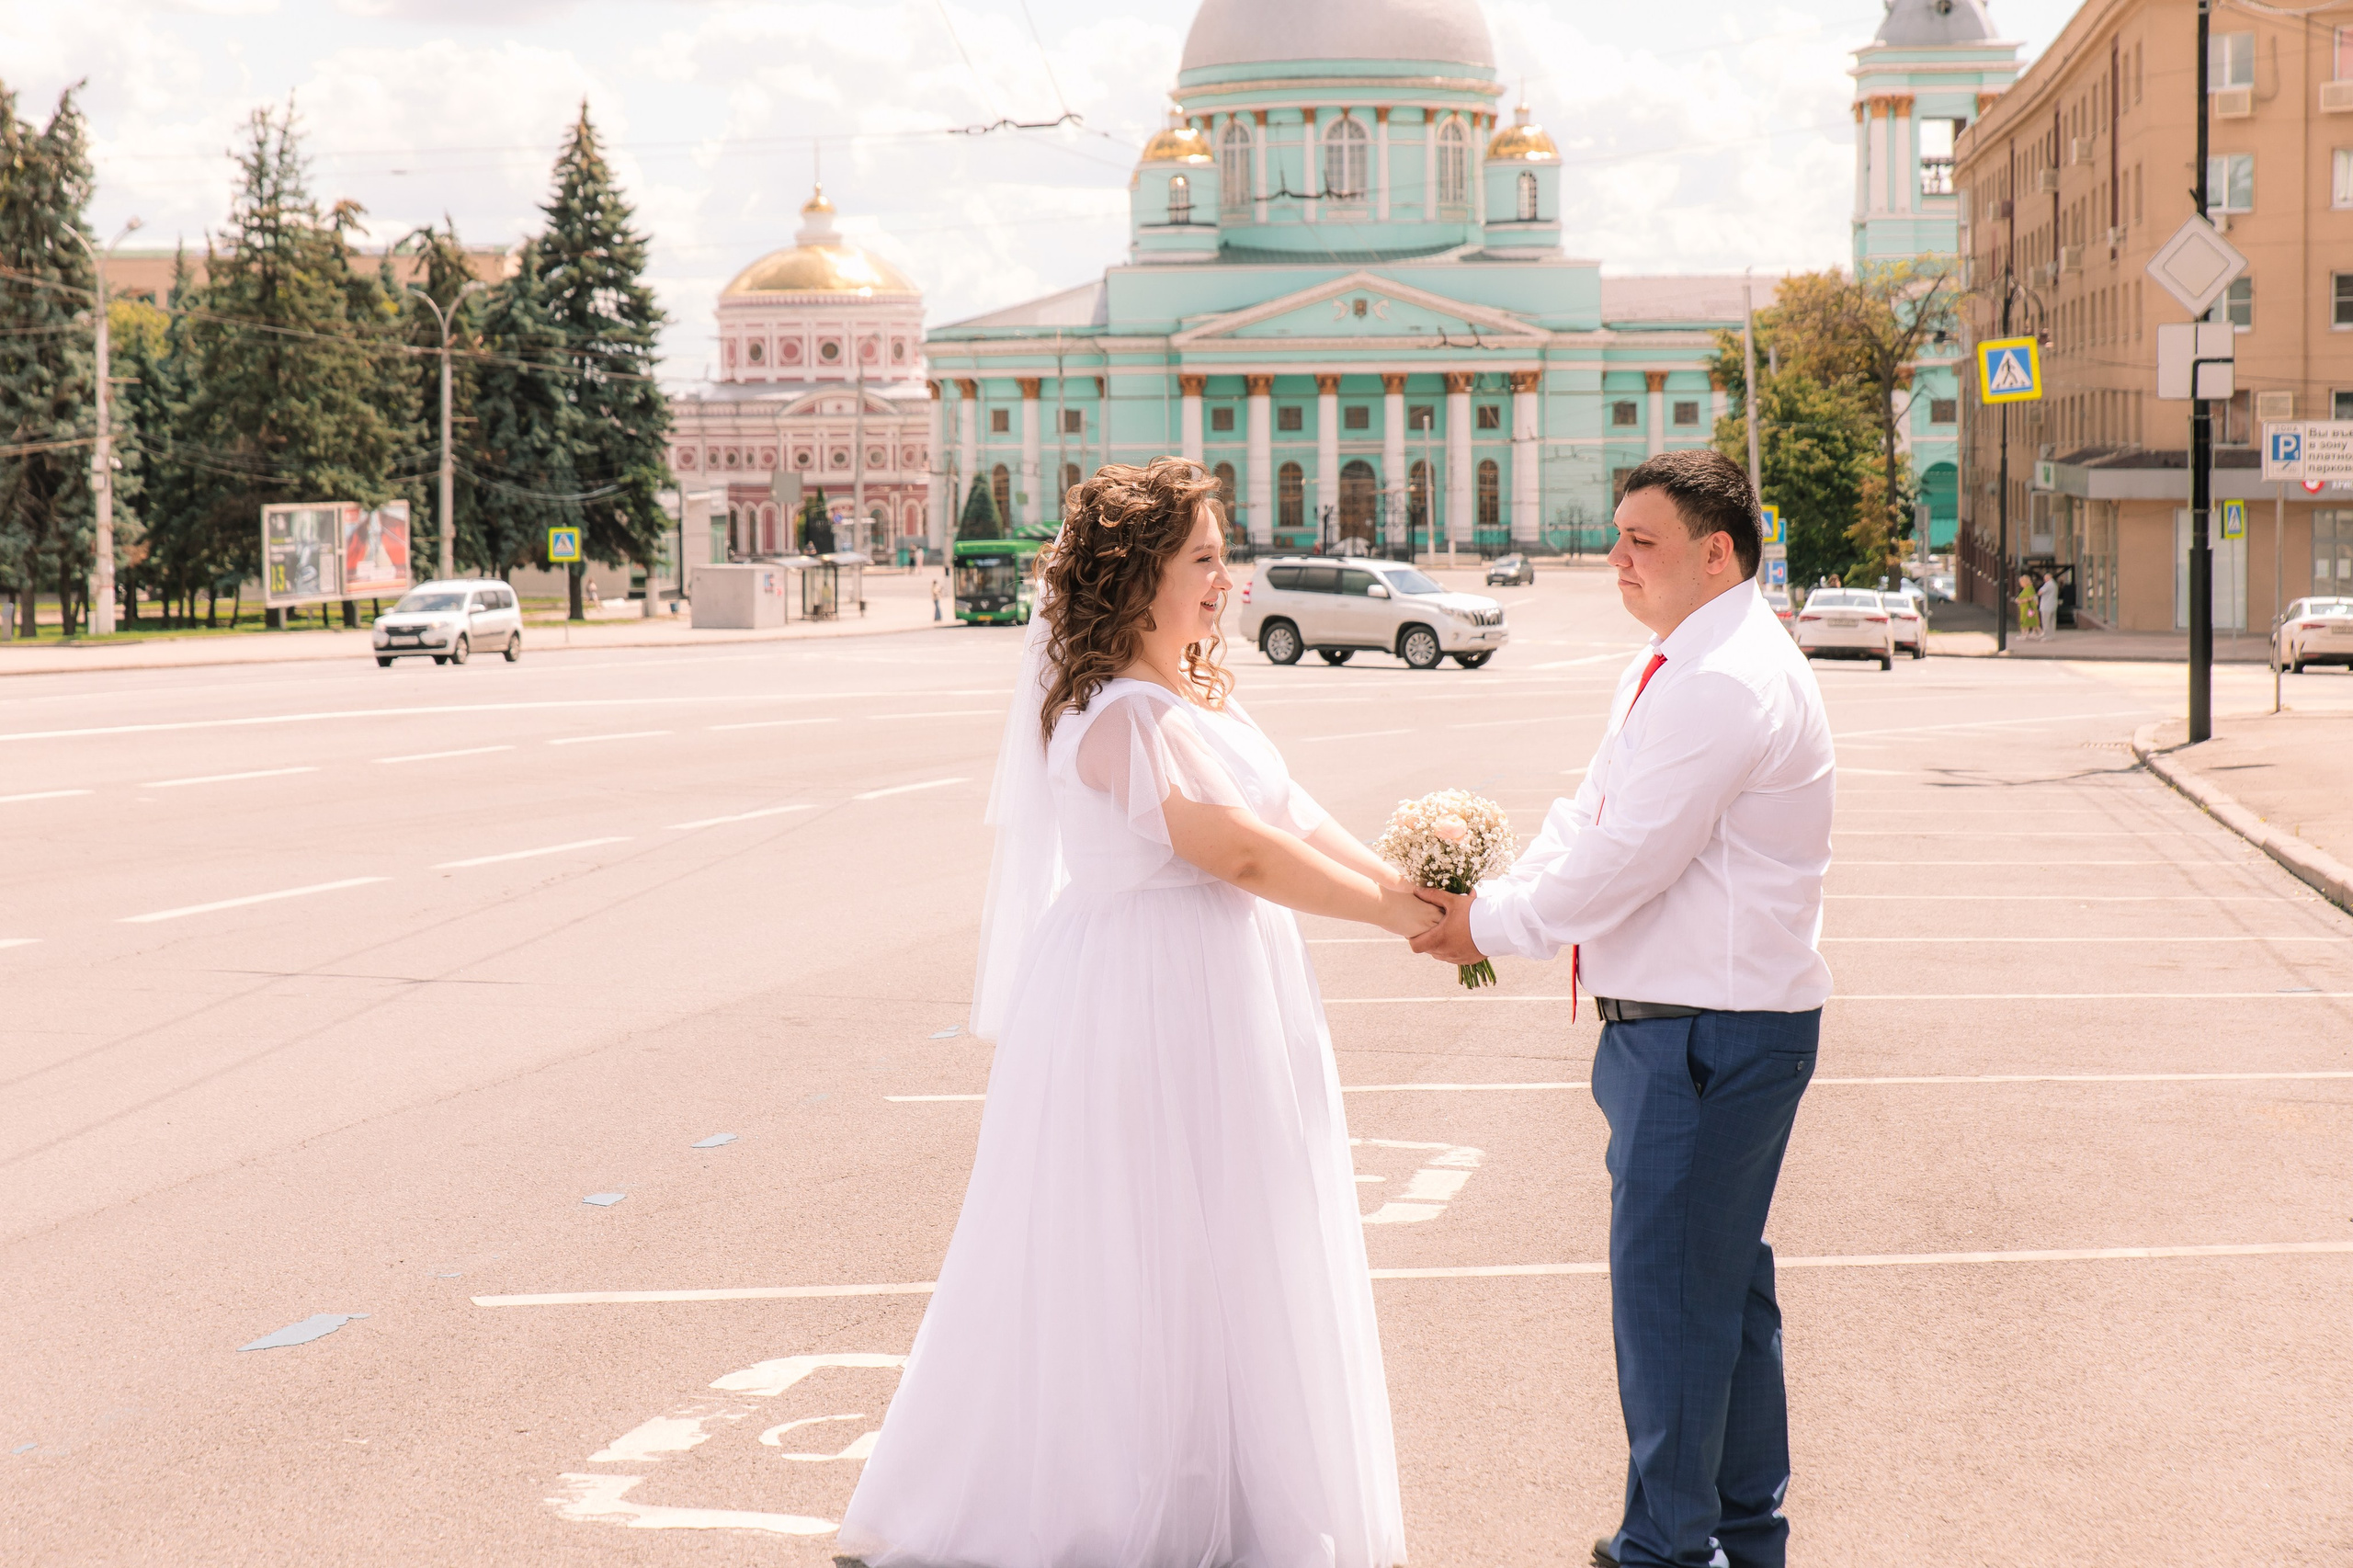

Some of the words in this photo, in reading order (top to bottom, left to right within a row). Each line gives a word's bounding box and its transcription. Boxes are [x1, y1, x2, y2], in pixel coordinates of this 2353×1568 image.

[2309, 427, 2328, 437] Вы
[2320, 441, 2347, 450] зону
[271, 564, 285, 592] 13
